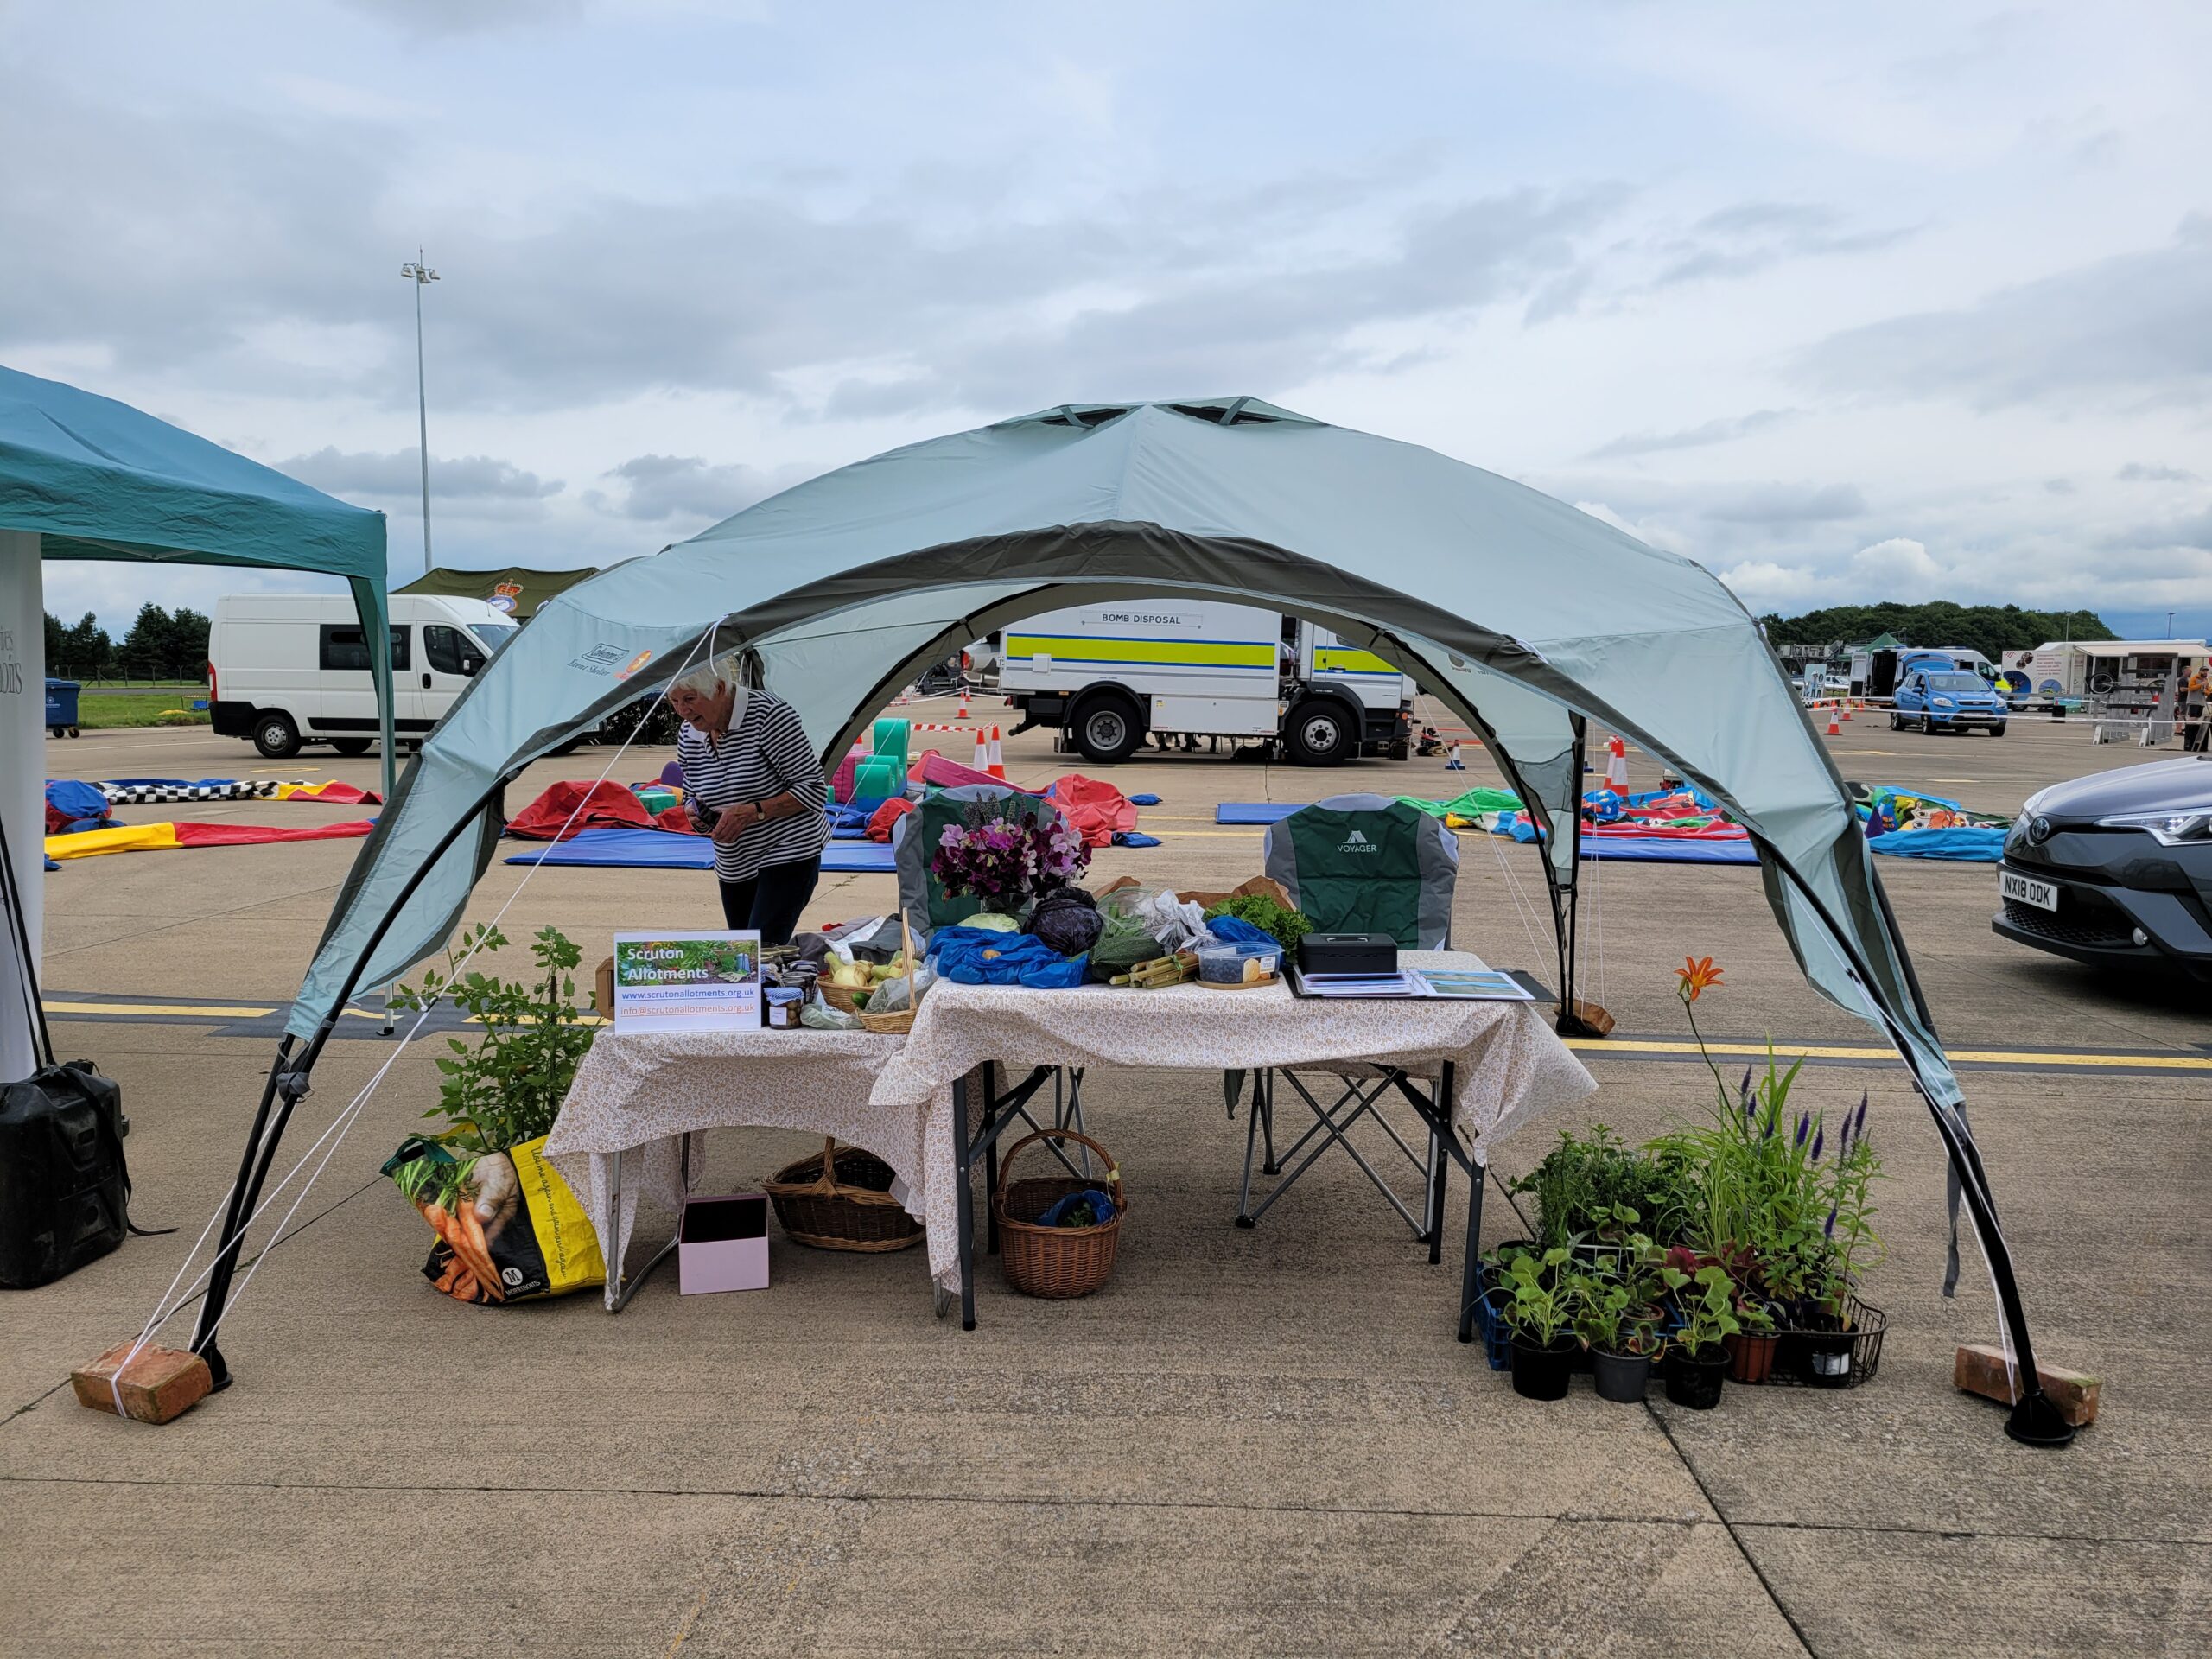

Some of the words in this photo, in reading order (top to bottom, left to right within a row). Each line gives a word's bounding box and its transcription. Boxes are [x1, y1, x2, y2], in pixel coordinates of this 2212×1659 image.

[1102, 613, 1129, 622] BOMB
[1133, 615, 1181, 624] DISPOSAL
[1337, 844, 1377, 853] VOYAGER
[2005, 875, 2027, 899] NX18
[2030, 882, 2050, 906] ODK
[627, 948, 684, 961] Scruton
[627, 967, 709, 981] Allotments
[621, 988, 754, 1000] www.scrutonallotments.org.uk
[620, 1003, 754, 1015] info@scrutonallotments.org.uk
[531, 1145, 542, 1166] Use
[537, 1165, 545, 1179] me
[537, 1179, 552, 1202] again
[549, 1203, 561, 1215] and
[555, 1236, 569, 1251] and
[505, 1269, 520, 1283] M
